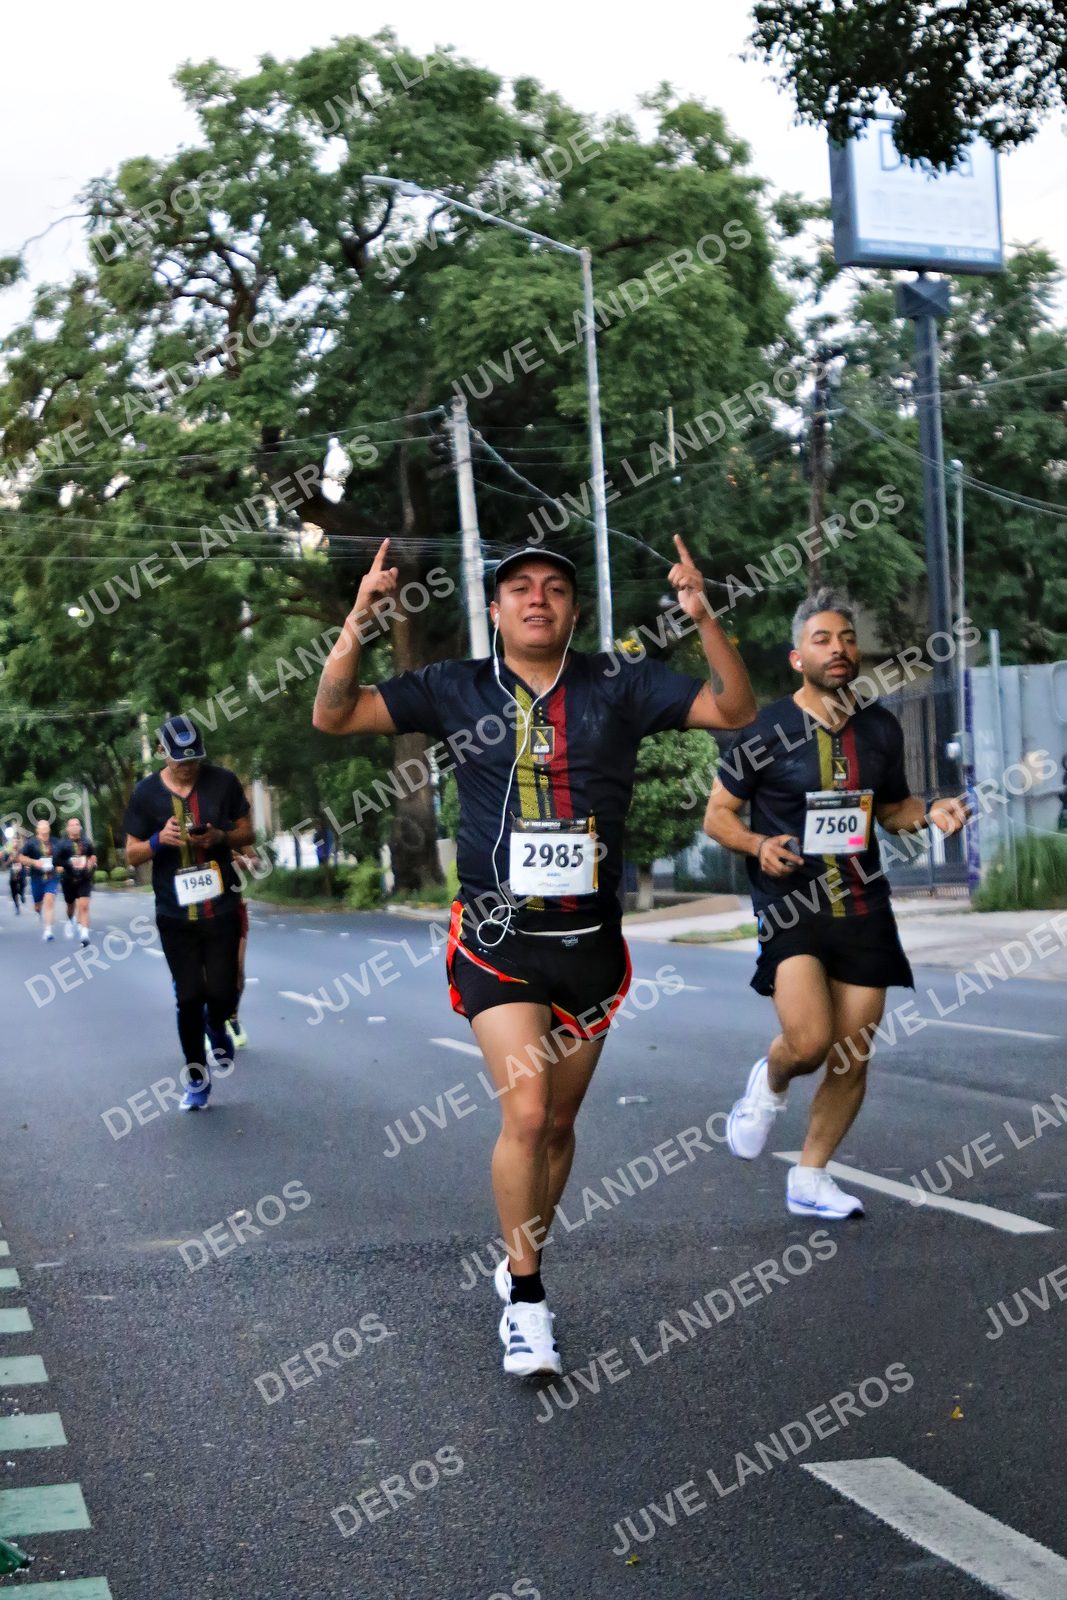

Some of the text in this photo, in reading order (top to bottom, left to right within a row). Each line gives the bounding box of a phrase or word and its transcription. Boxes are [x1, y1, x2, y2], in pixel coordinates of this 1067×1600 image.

[815, 815, 858, 834] 7560
[522, 842, 584, 868] 2985
[182, 874, 213, 890] 1948
